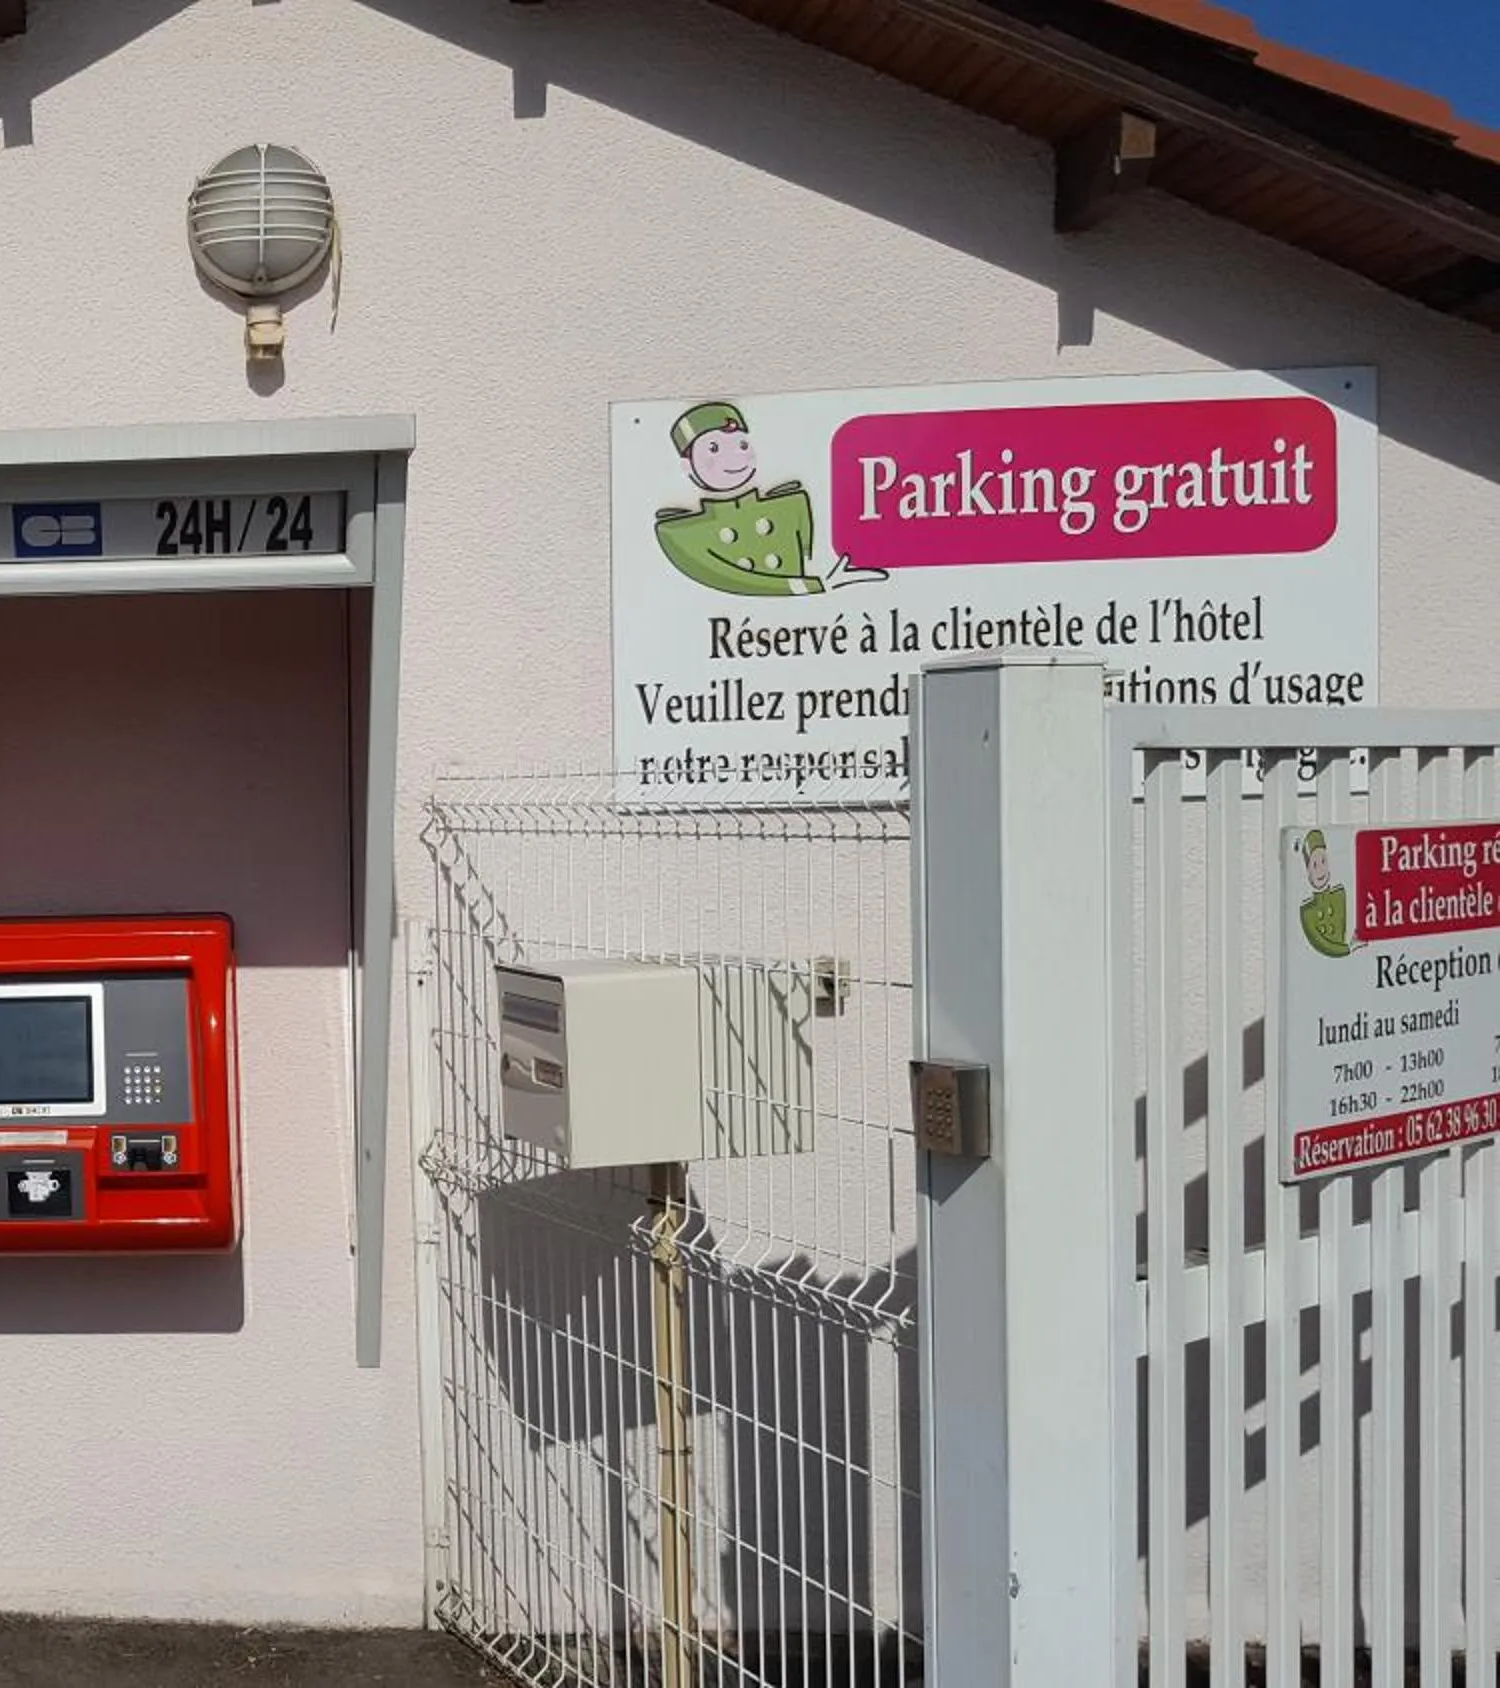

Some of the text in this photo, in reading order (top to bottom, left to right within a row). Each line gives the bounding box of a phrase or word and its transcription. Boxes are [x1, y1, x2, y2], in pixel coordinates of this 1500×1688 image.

[858, 438, 1314, 536] Parking gratuit
[708, 614, 848, 660] Réservé
[859, 611, 879, 653] à
[889, 607, 921, 653] la
[931, 601, 1084, 651] clientèle
[1095, 600, 1138, 645] de
[635, 677, 786, 725] Veuillez
[639, 746, 730, 785] notre
[1379, 831, 1477, 878] Parking
[1365, 881, 1494, 929] à la clientèle
[1376, 946, 1492, 993] Réception
[1317, 999, 1460, 1047] lundi au samedi
[1332, 1059, 1374, 1084] 7h00
[1401, 1047, 1445, 1074] 13h00
[1330, 1091, 1378, 1118] 16h30
[1401, 1079, 1445, 1104] 22h00
[1298, 1123, 1395, 1170] Réservation
[1406, 1112, 1424, 1148] 05
[1426, 1108, 1443, 1142] 62
[1481, 1097, 1497, 1131] 30
